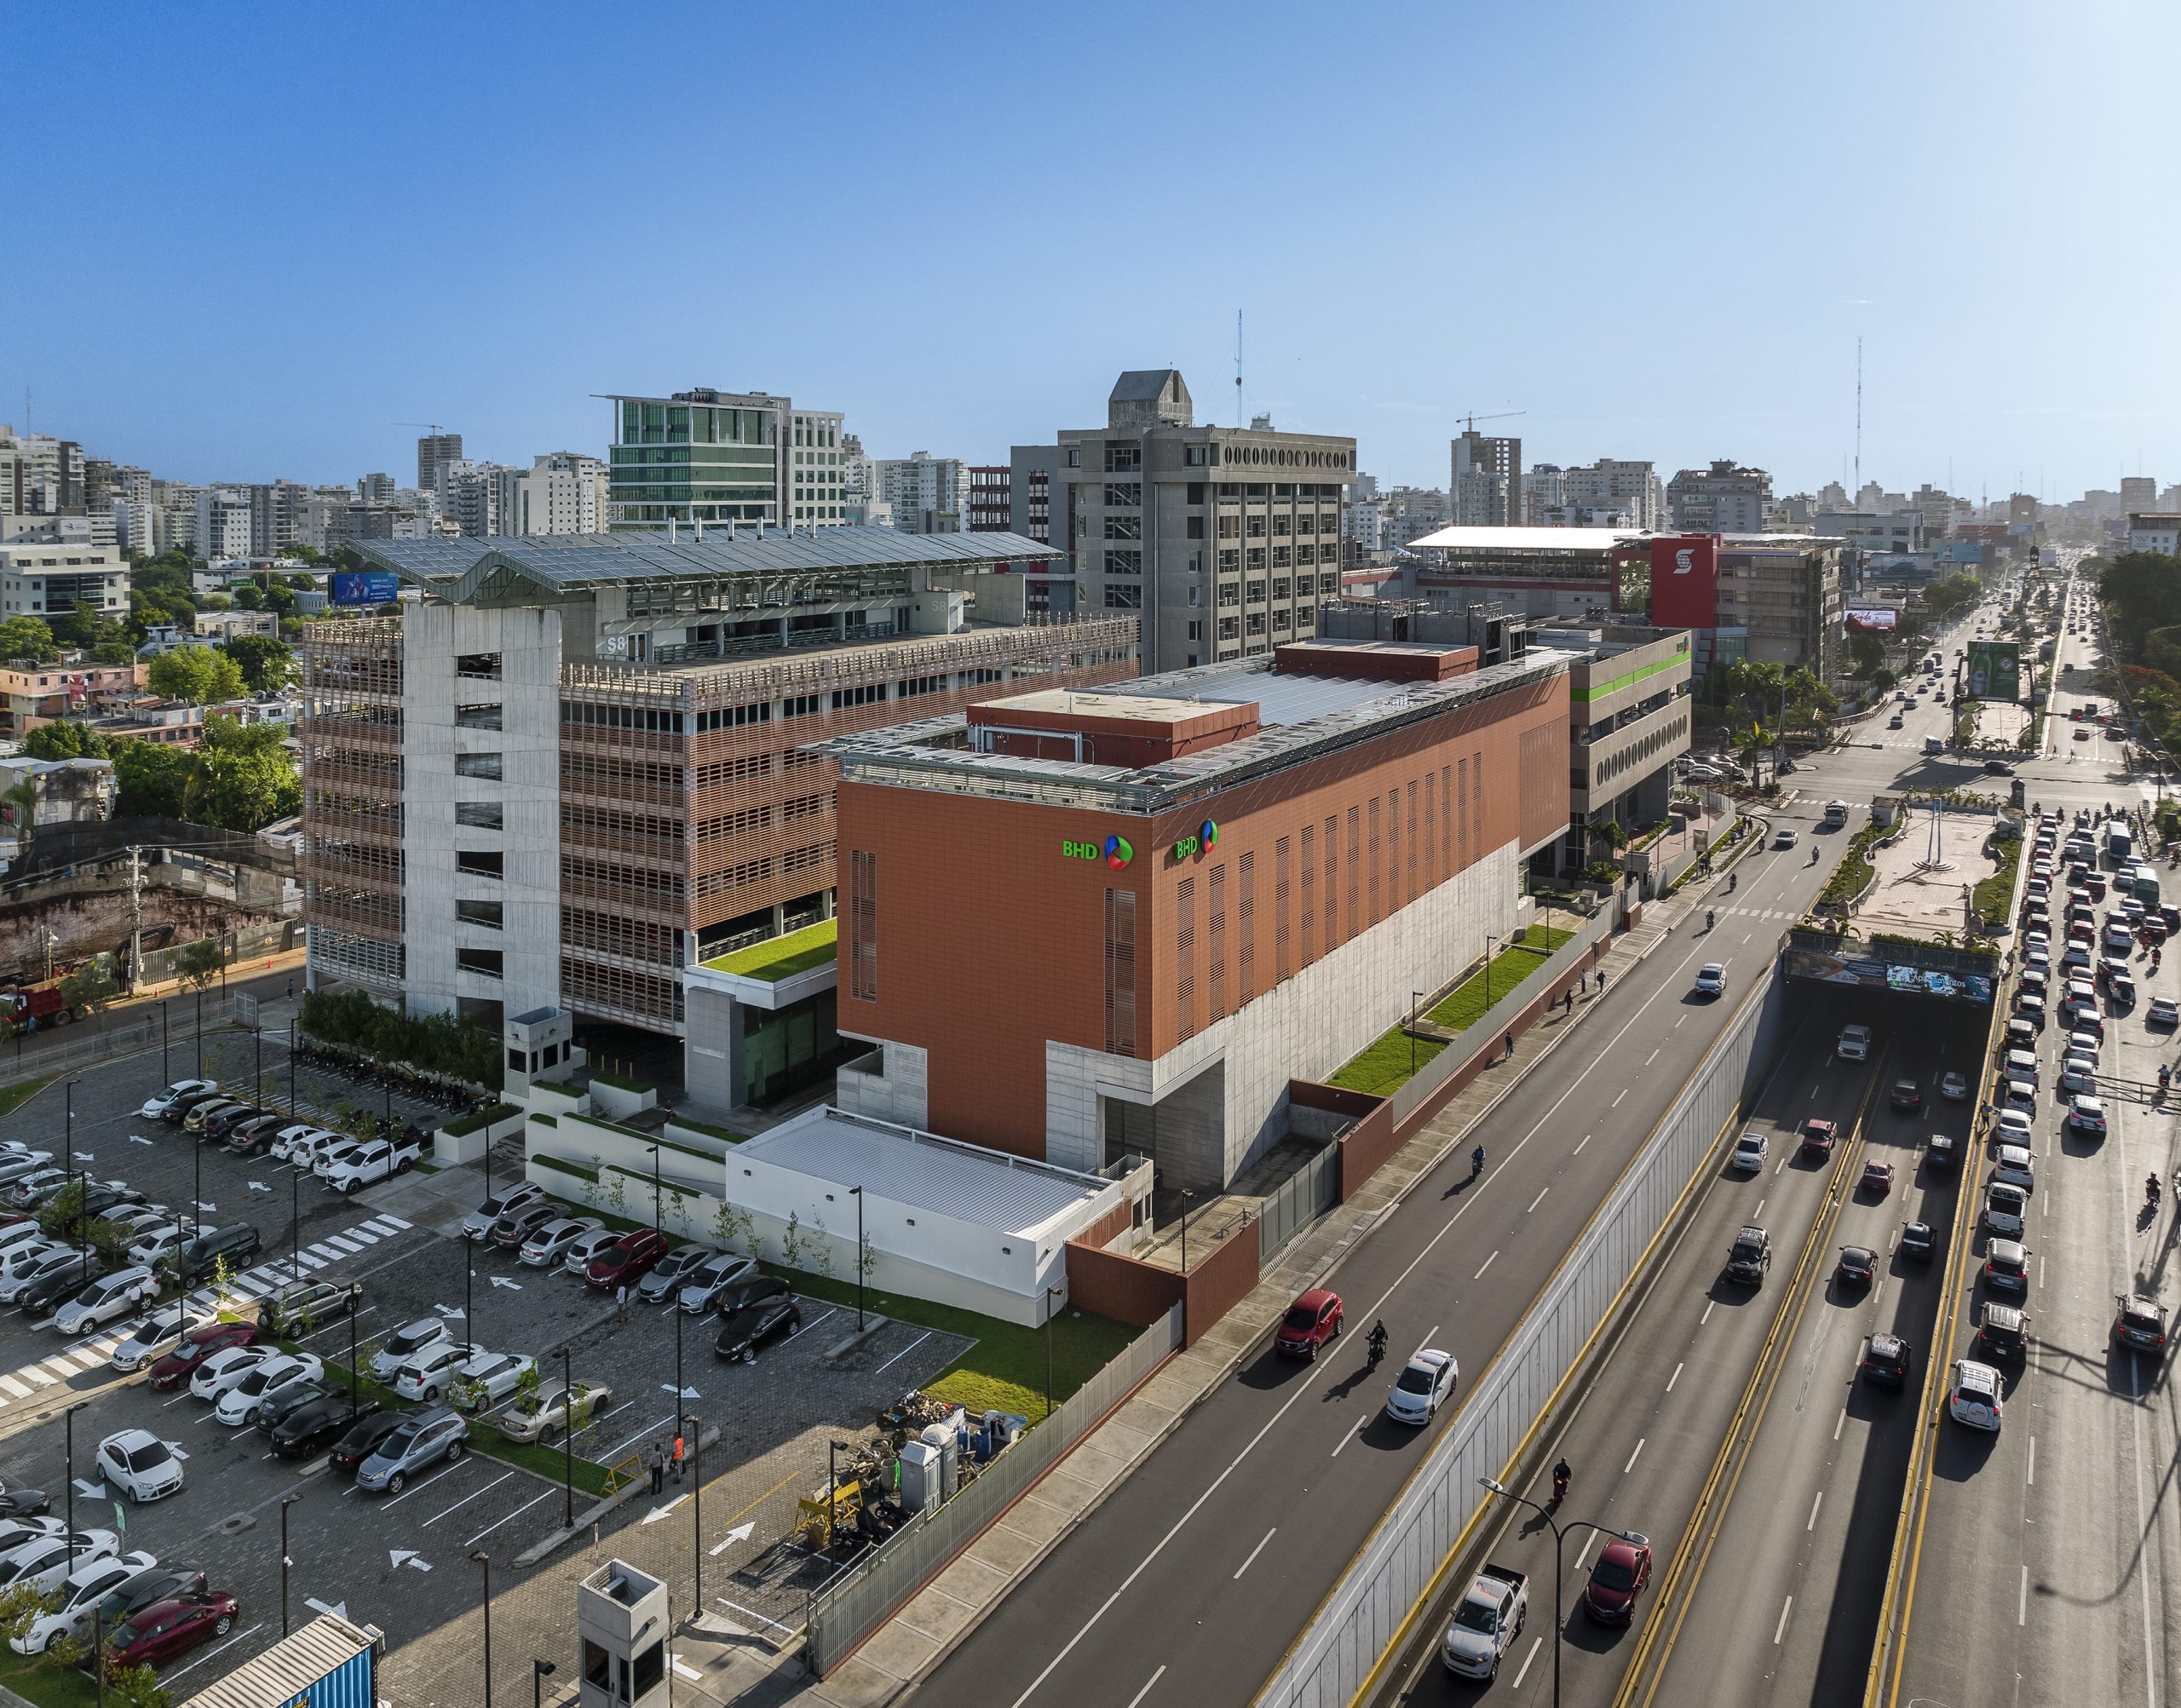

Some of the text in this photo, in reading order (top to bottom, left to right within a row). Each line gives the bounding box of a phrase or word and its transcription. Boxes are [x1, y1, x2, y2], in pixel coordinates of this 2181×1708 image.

[931, 600, 946, 612] S8
[607, 636, 624, 652] S8
[1062, 840, 1098, 860] BHD
[1177, 837, 1198, 859] BHD
